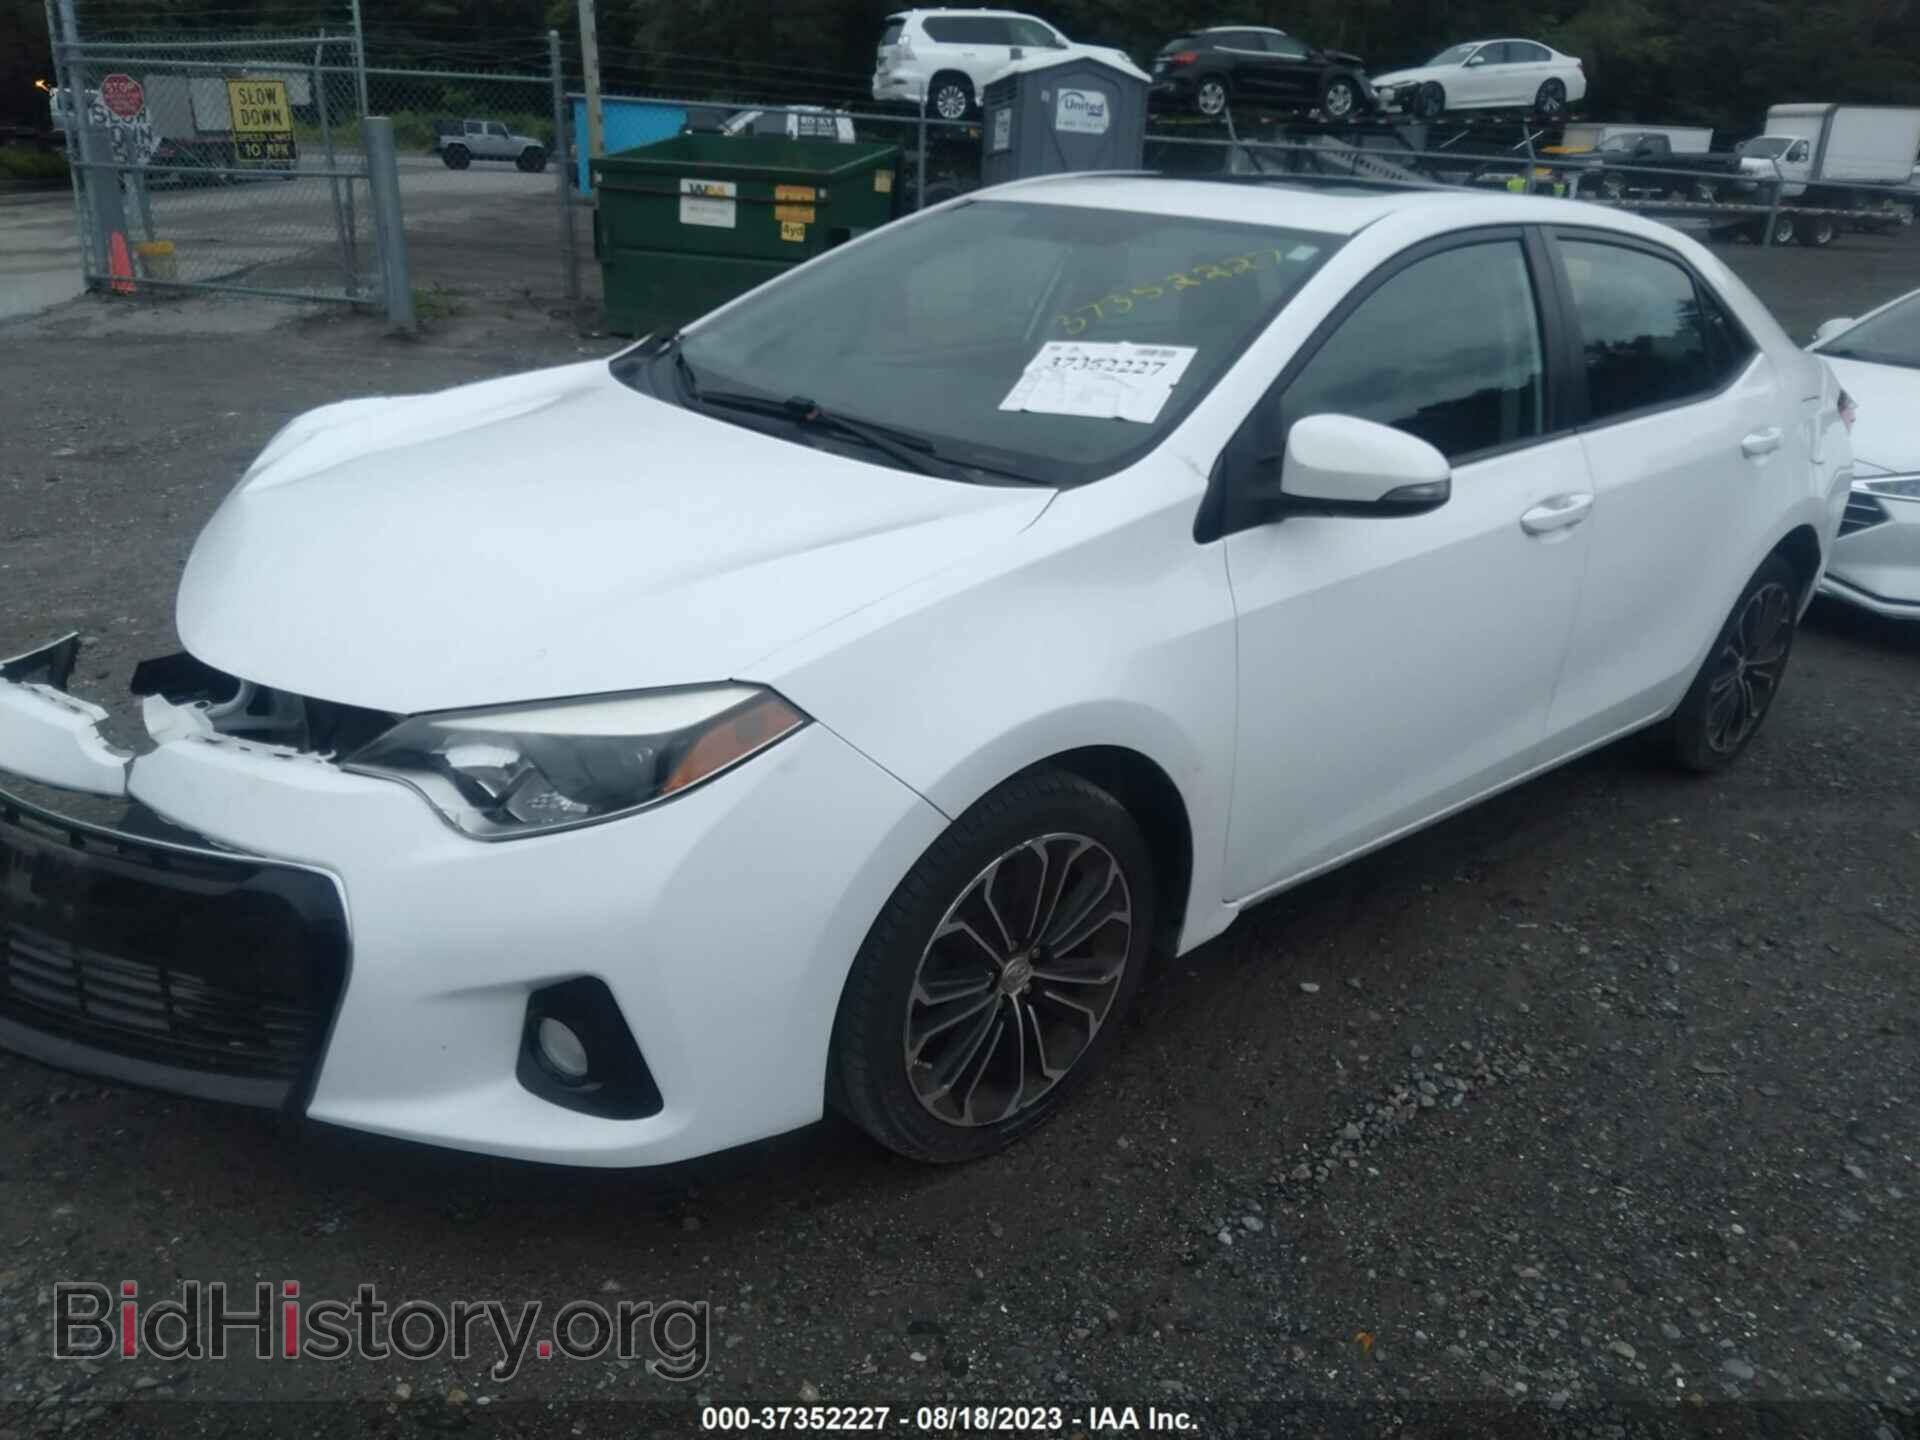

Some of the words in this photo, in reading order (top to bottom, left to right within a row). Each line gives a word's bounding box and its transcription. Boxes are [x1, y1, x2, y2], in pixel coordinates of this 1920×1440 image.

[238, 87, 277, 105] SLOW
[1065, 98, 1105, 113] United
[240, 108, 283, 126] DOWN
[245, 142, 261, 157] 10
[1051, 355, 1166, 377] 37352227
